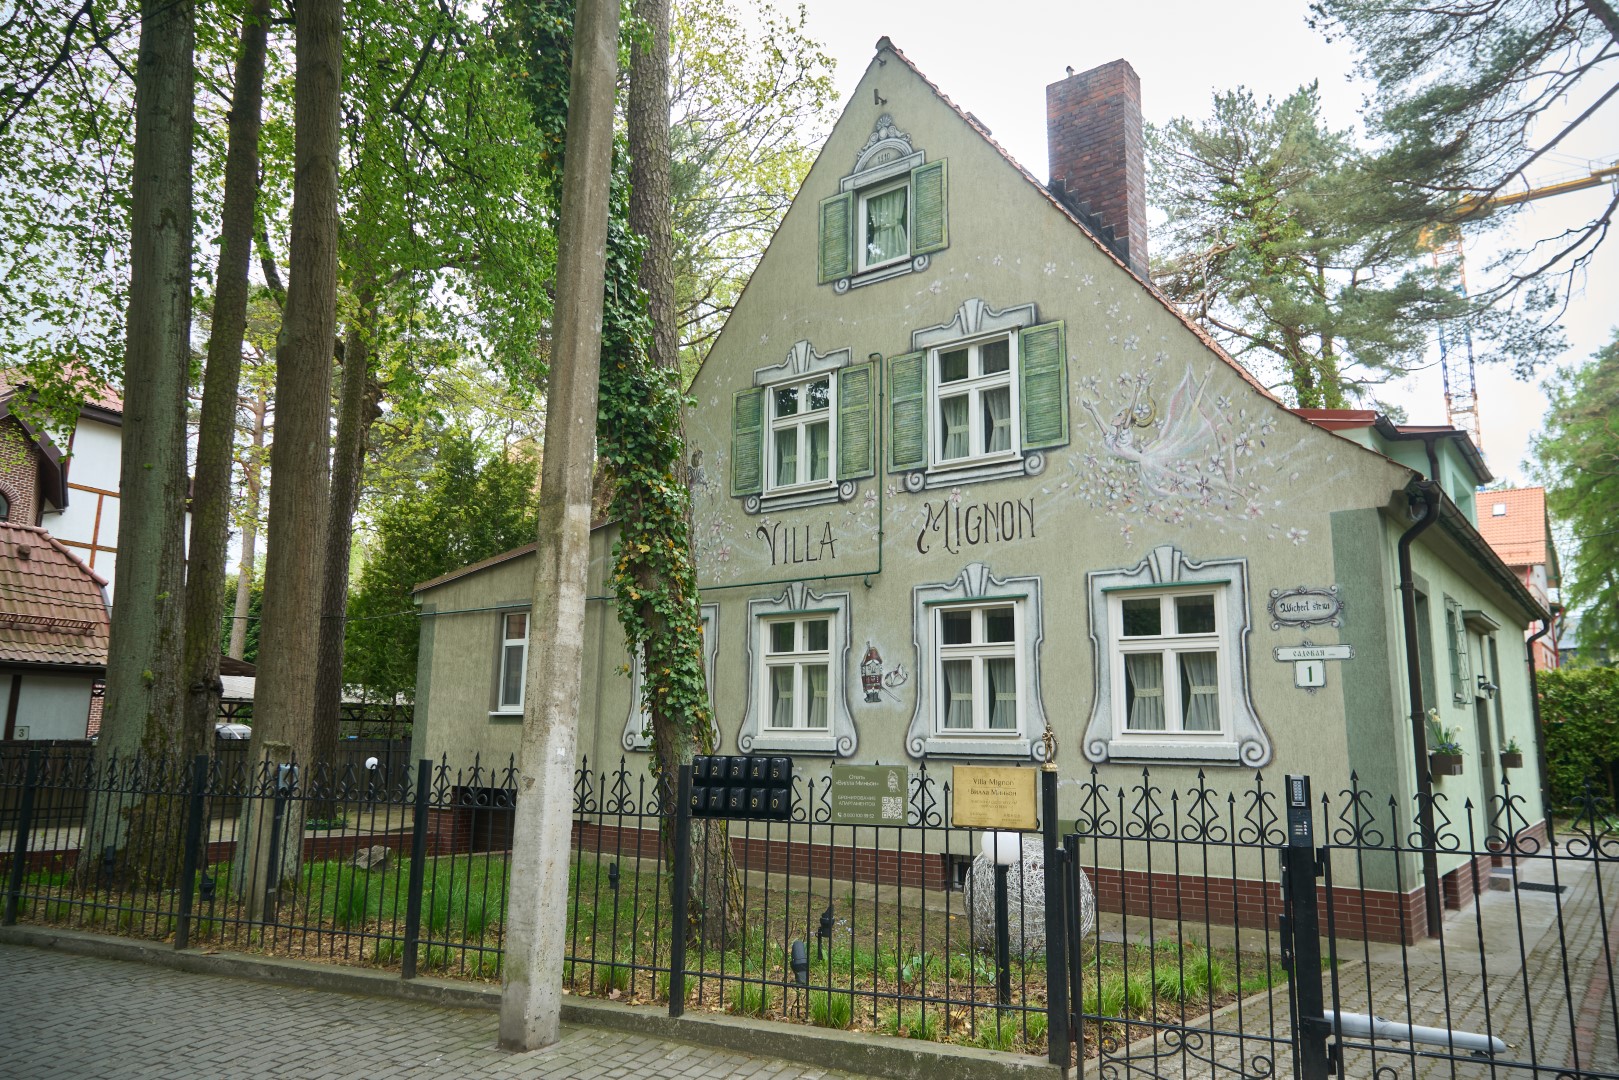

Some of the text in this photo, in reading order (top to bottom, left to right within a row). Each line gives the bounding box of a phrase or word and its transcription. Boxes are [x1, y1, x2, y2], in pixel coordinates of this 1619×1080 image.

[756, 498, 1036, 566] VILLA MIGNON
[1307, 665, 1313, 683] 1
[18, 728, 25, 738] 3
[693, 765, 779, 778] 1 2 3 4 5
[691, 795, 779, 808] 6 7 8 9 0
